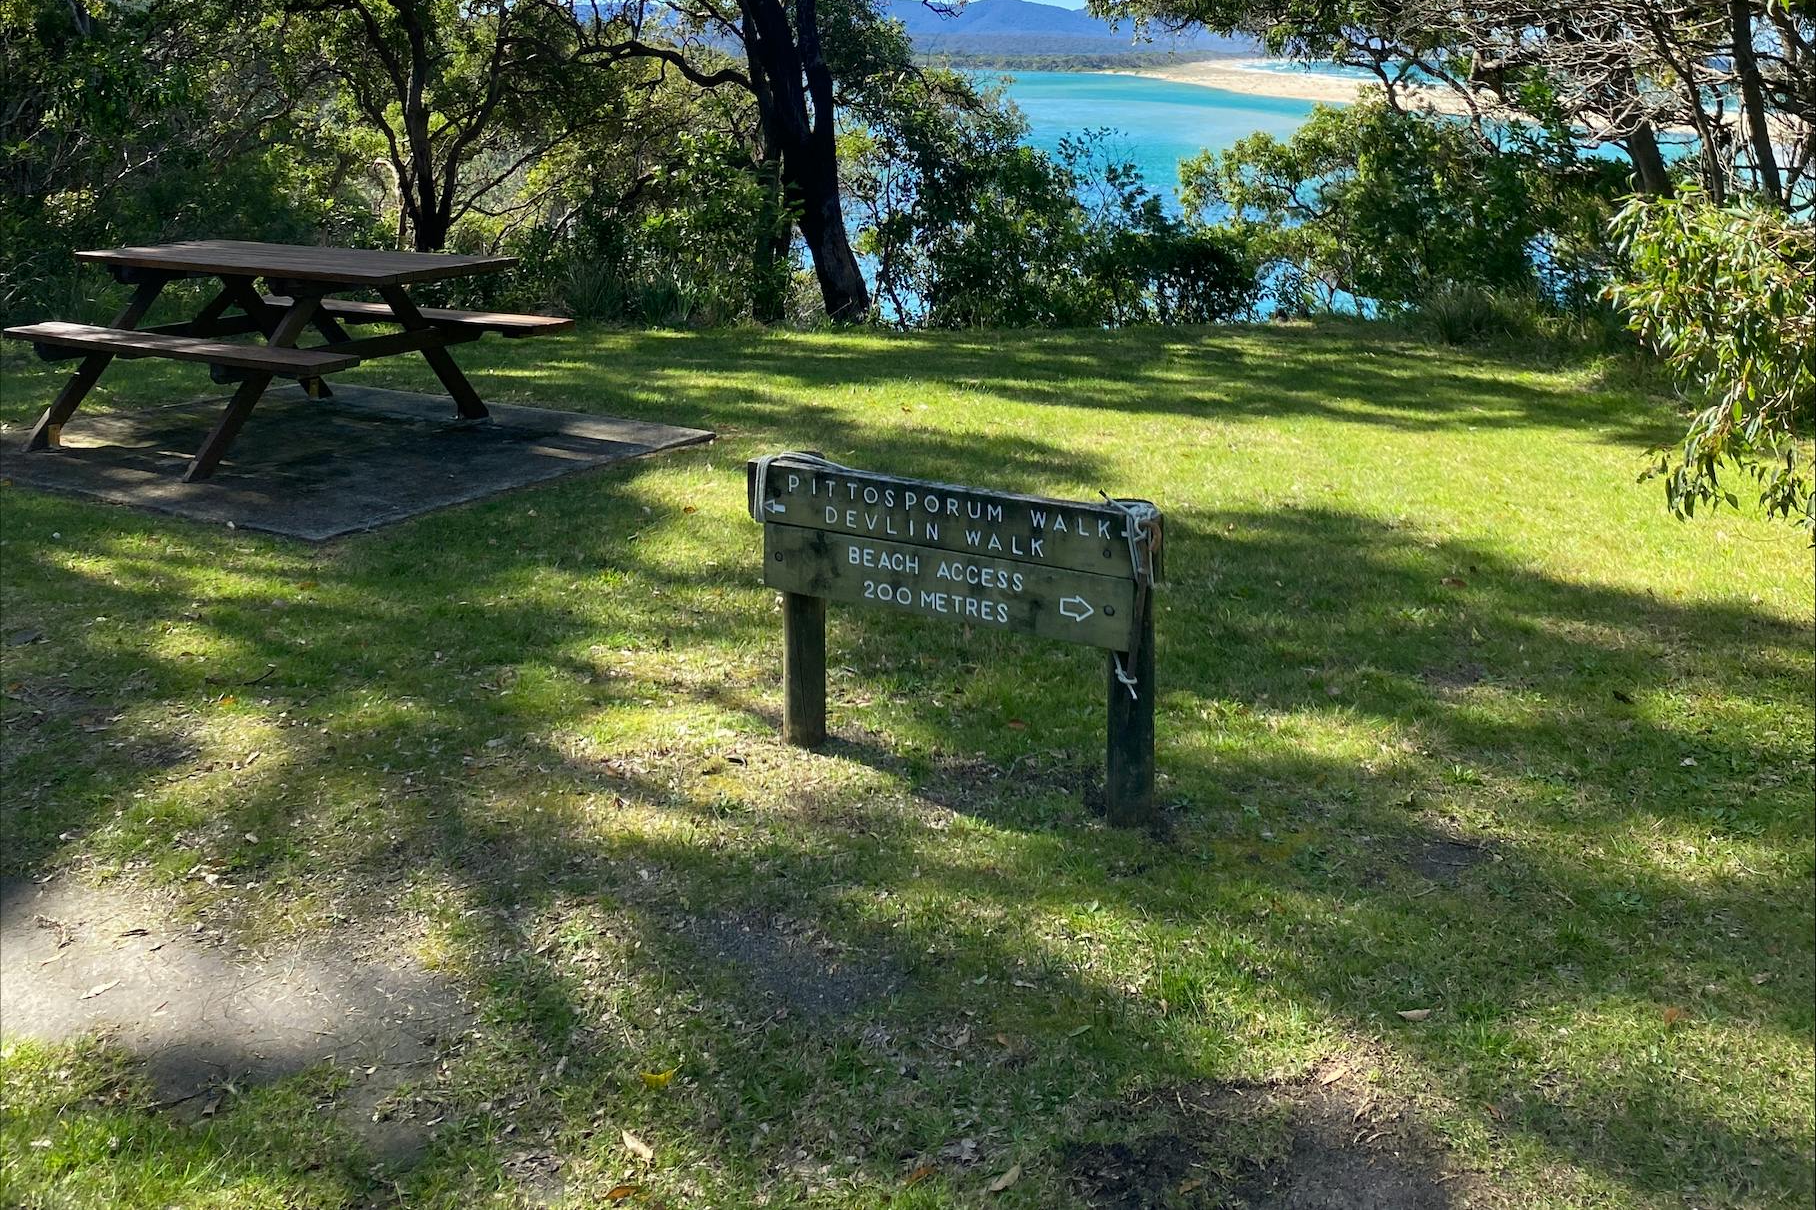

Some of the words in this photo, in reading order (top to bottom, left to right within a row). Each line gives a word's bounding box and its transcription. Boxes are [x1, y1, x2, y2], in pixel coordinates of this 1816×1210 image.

[788, 474, 1003, 523] PITTOSPORUM
[1030, 509, 1111, 540] WALK
[825, 506, 939, 541] DEVLIN
[965, 529, 1044, 558] WALK
[848, 546, 919, 575] BEACH
[936, 560, 1024, 592] ACCESS
[863, 580, 912, 605] 200
[920, 590, 1009, 623] METRES
